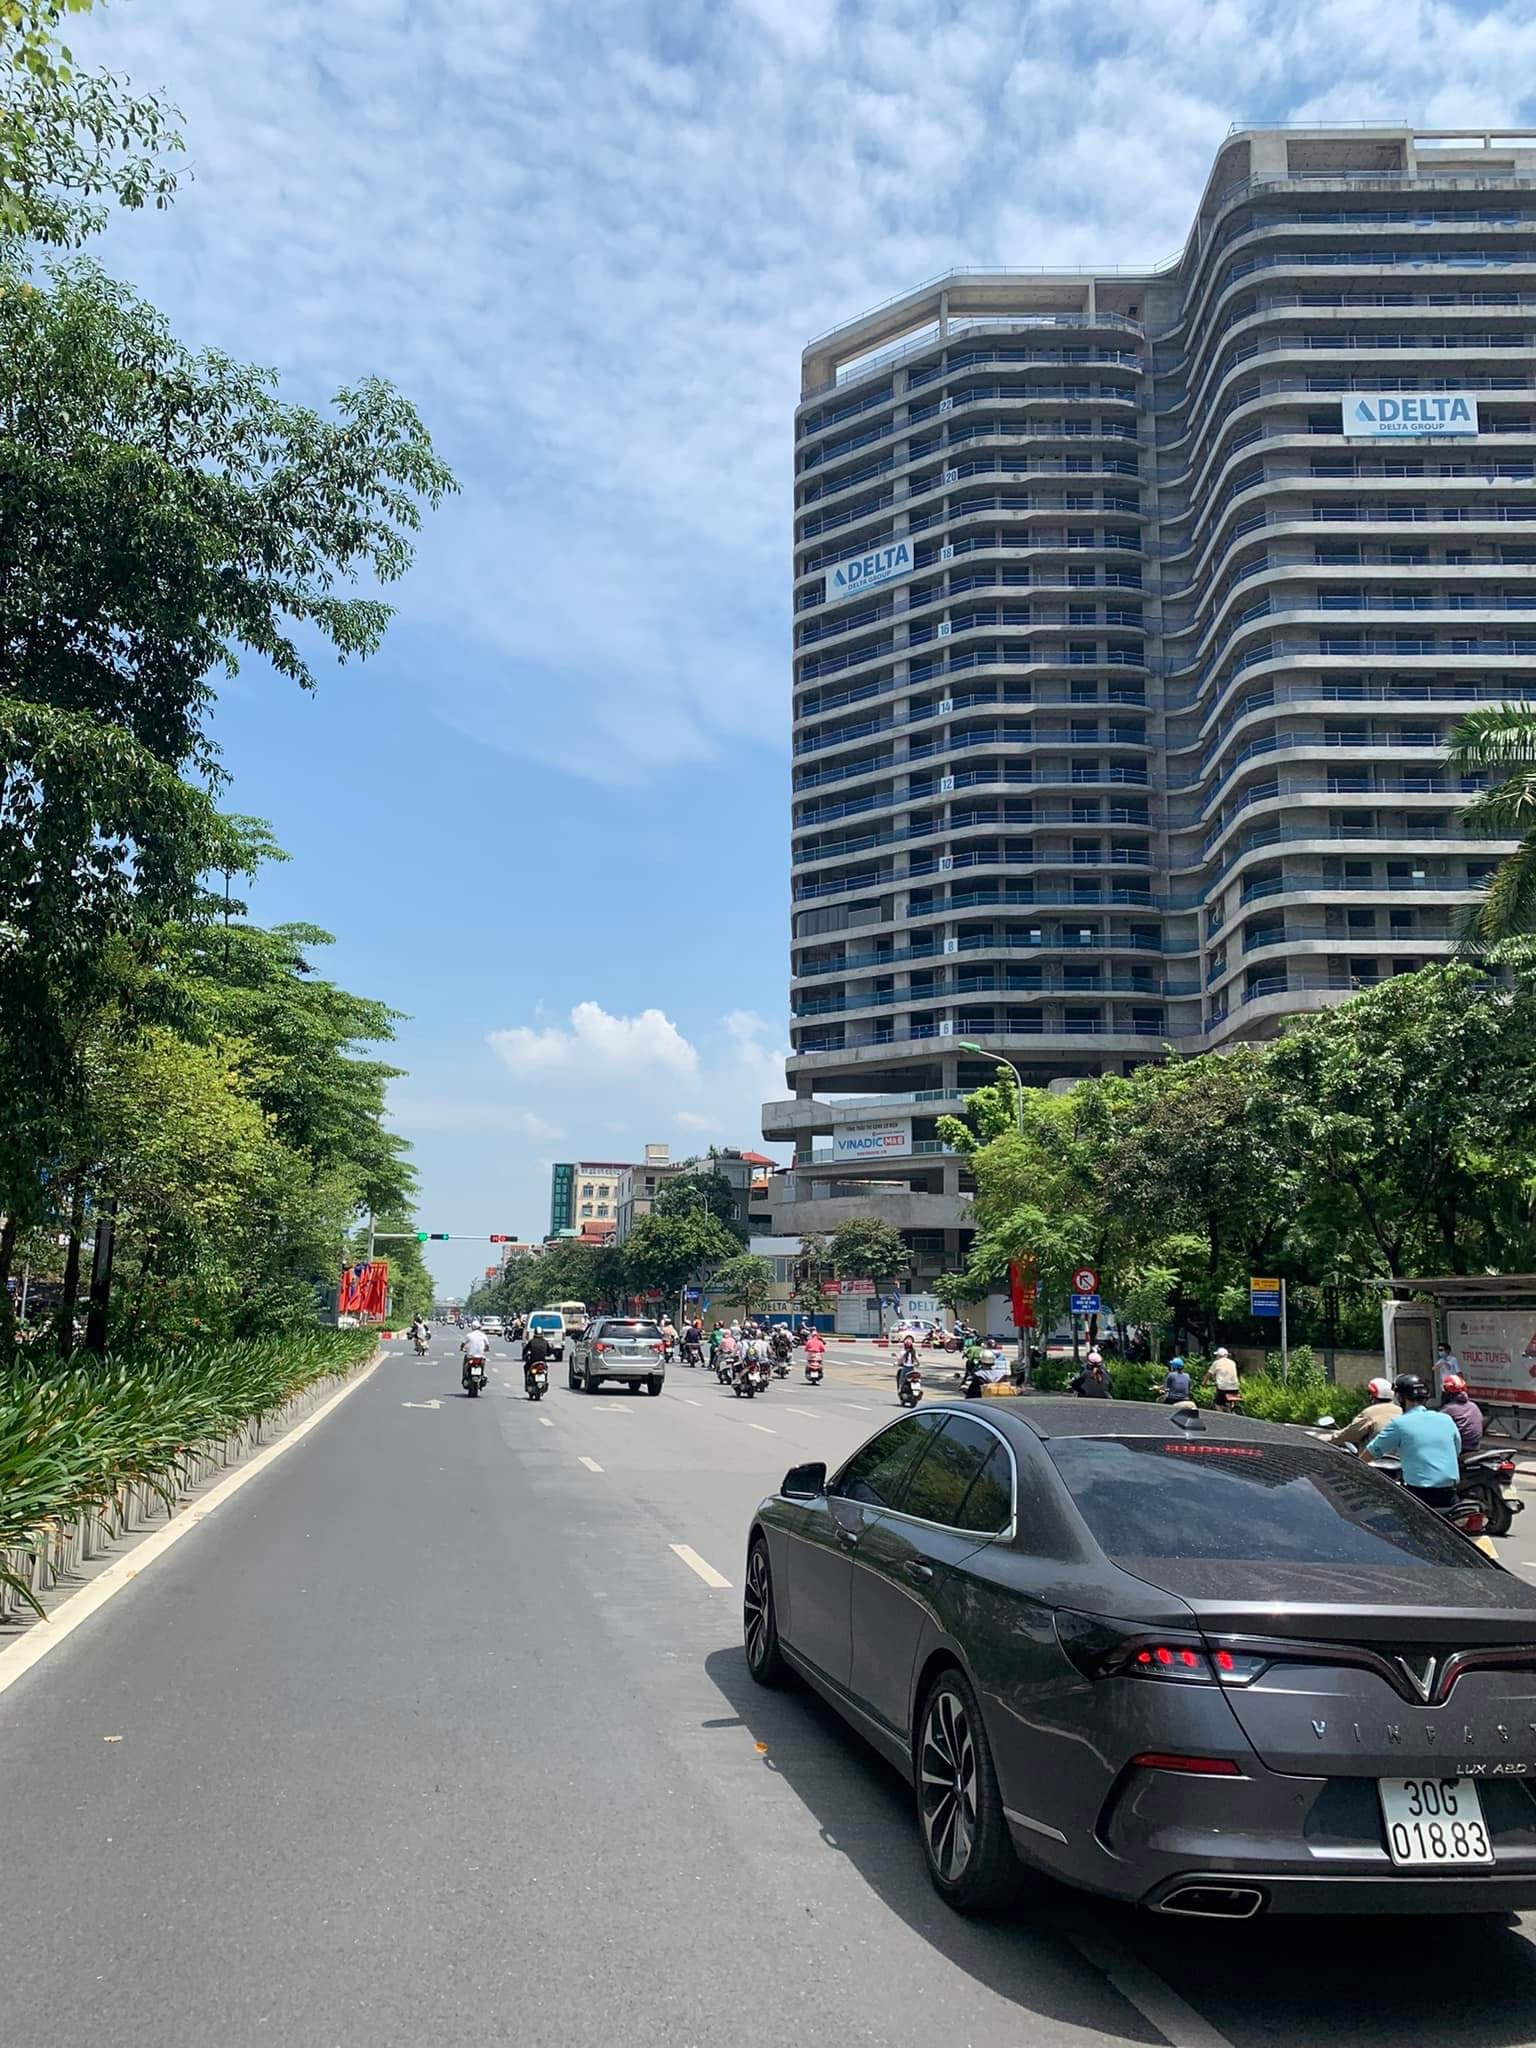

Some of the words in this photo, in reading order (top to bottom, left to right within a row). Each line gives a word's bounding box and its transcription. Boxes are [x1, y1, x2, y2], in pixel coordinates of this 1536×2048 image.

[941, 400, 952, 412] 22
[1378, 398, 1471, 421] DELTA
[1410, 423, 1445, 431] GROUP
[946, 471, 957, 483] 20
[847, 543, 909, 583] DELTA
[847, 579, 867, 590] DELTA
[868, 570, 892, 583] GROUP
[943, 778, 953, 789] 12
[942, 858, 951, 869] 10
[838, 1137, 883, 1150] VINADIC
[760, 1302, 788, 1312] DELTA
[908, 1300, 944, 1312] DELT
[1456, 1764, 1486, 1774] LUX
[1403, 1781, 1459, 1816] 30G
[1392, 1822, 1487, 1860] 018.83
